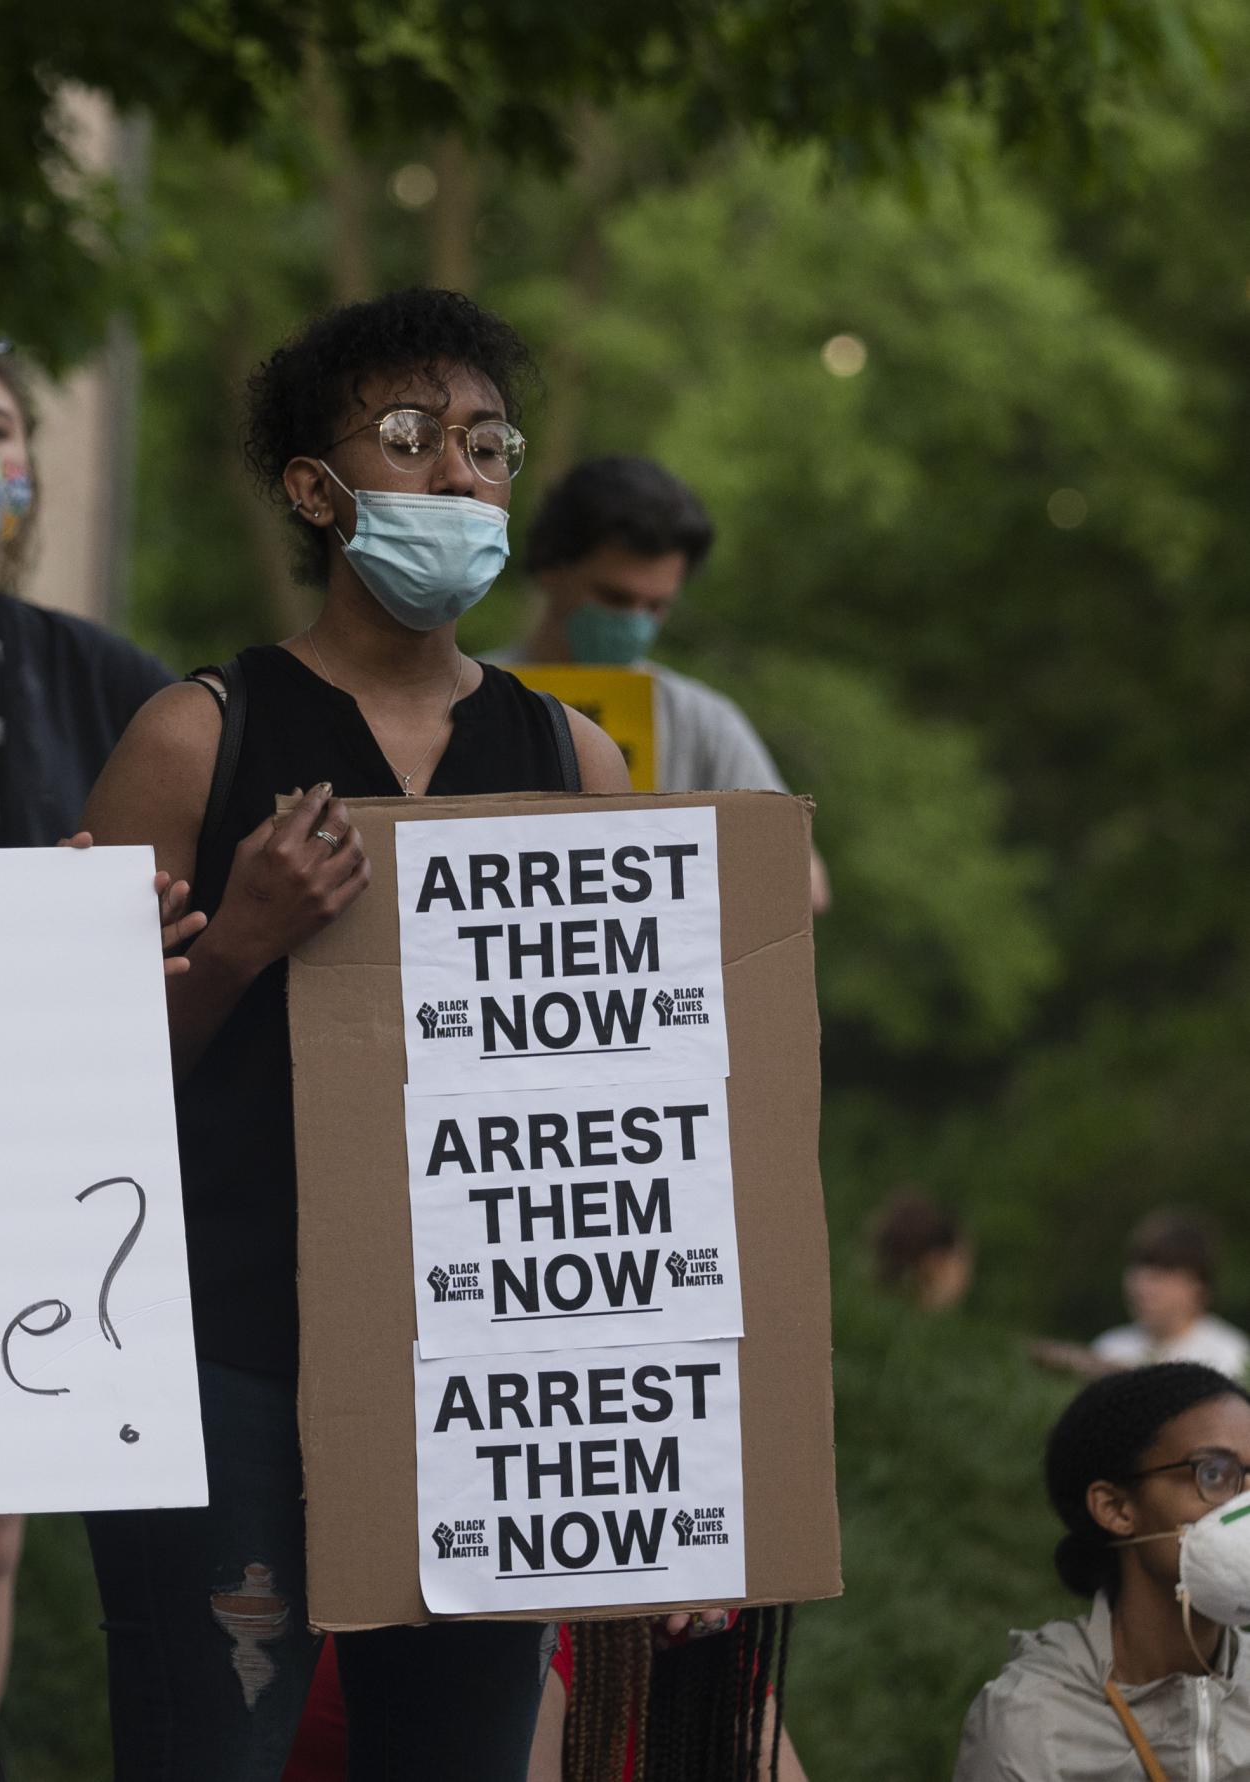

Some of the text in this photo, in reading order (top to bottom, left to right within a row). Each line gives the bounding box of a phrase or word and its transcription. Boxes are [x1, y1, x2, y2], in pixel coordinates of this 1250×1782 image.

[415, 843, 699, 913] ARREST
[457, 916, 660, 982] THEM
[673, 987, 705, 999] BLACK
[437, 1000, 469, 1012] BLACK
[676, 1001, 703, 1012] LIVES
[441, 1013, 468, 1025] LIVES
[480, 987, 648, 1053] NOW
[672, 1013, 710, 1026] MATTER
[436, 1026, 473, 1038] MATTER
[425, 1103, 710, 1177] ARREST
[468, 1177, 672, 1244] THEM
[686, 1248, 719, 1260] BLACK
[448, 1263, 480, 1275] BLACK
[690, 1261, 718, 1273] LIVES
[452, 1276, 479, 1287] LIVES
[491, 1249, 661, 1316] NOW
[685, 1274, 724, 1286] MATTER
[447, 1289, 484, 1301] MATTER
[433, 1362, 721, 1433] ARREST
[475, 1436, 680, 1502] THEM
[694, 1507, 725, 1519] BLACK
[454, 1519, 486, 1531] BLACK
[697, 1521, 723, 1532] LIVES
[457, 1533, 484, 1544] LIVES
[497, 1507, 668, 1573] NOW
[692, 1533, 729, 1545] MATTER
[452, 1546, 489, 1558] MATTER
